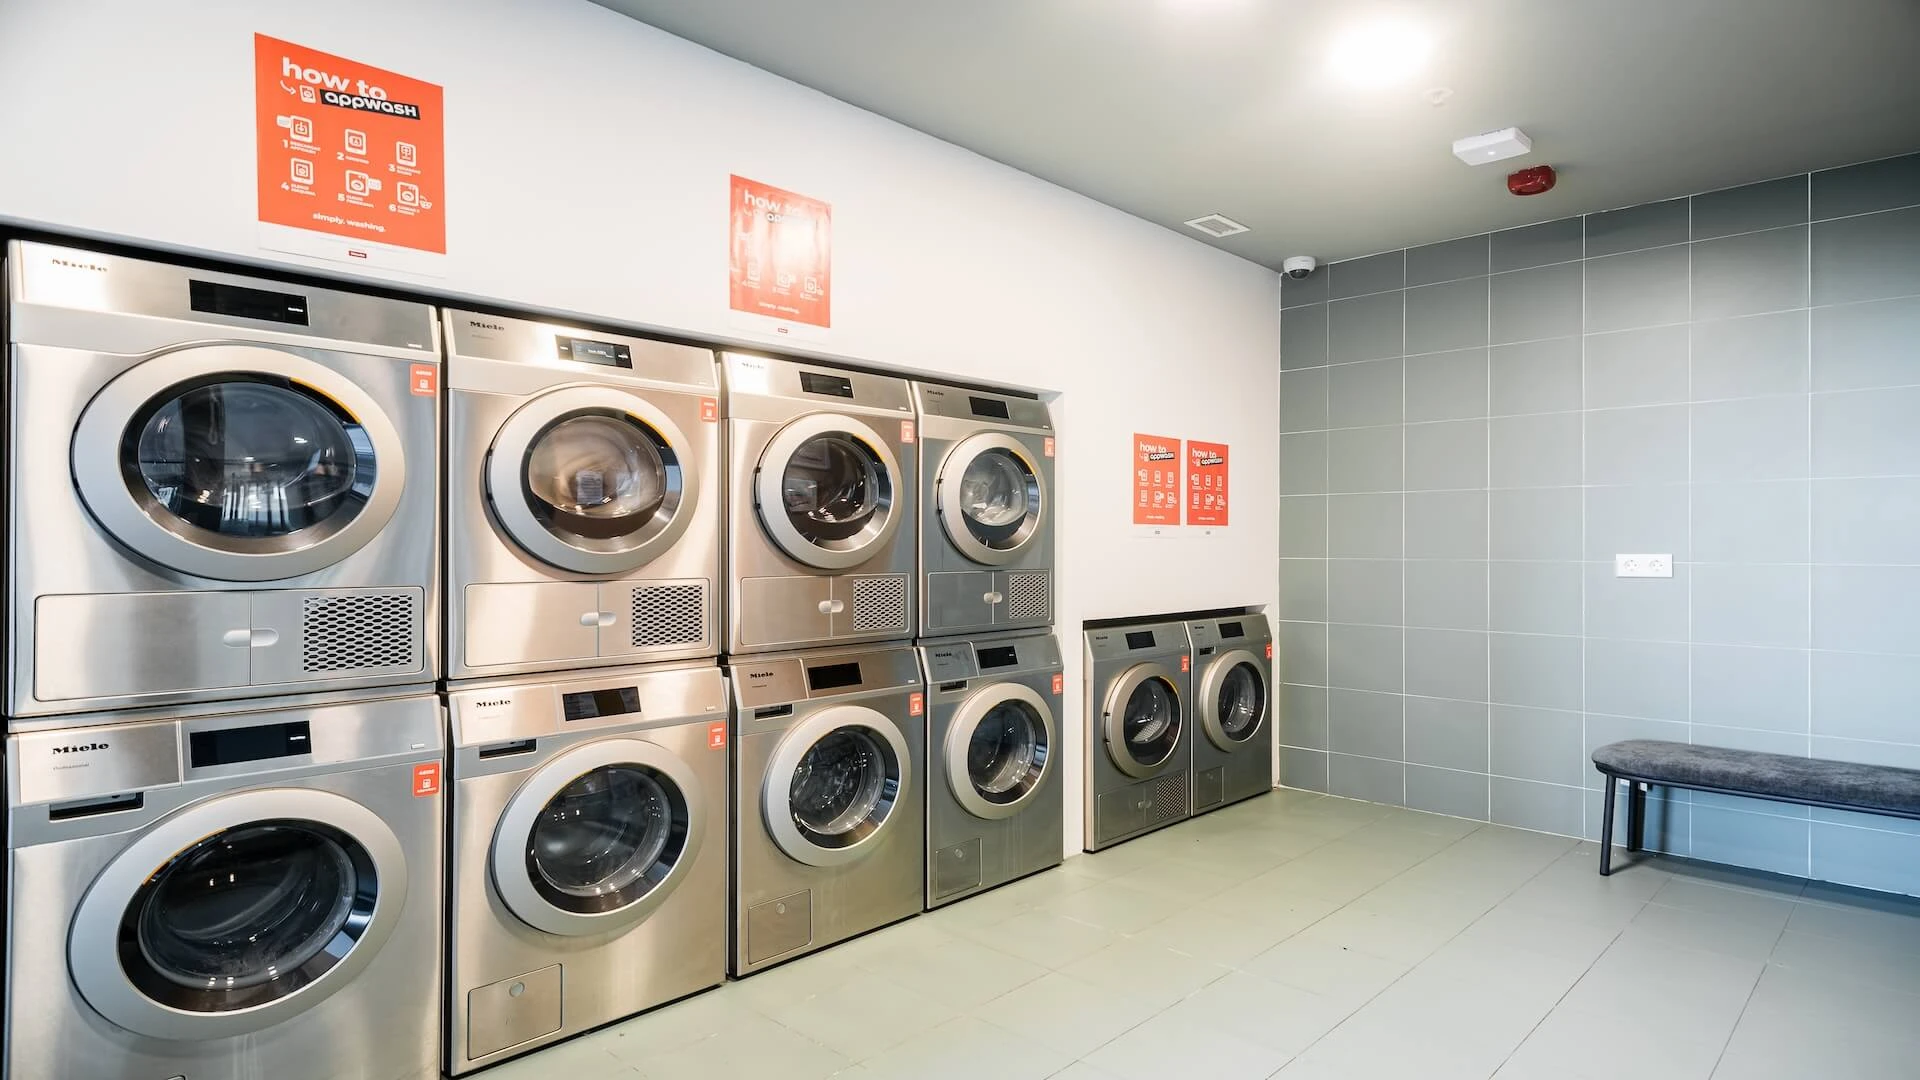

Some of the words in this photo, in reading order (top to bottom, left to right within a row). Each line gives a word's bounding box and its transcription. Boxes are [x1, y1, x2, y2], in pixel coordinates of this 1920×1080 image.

[282, 56, 350, 92] how
[356, 80, 388, 101] to
[282, 138, 289, 148] 1
[336, 151, 345, 160] 2
[388, 163, 396, 172] 3
[280, 181, 290, 191] 4
[337, 193, 346, 202] 5
[744, 188, 781, 212] how
[388, 203, 397, 212] 6
[470, 321, 505, 331] Miele
[52, 743, 109, 755] Miele
